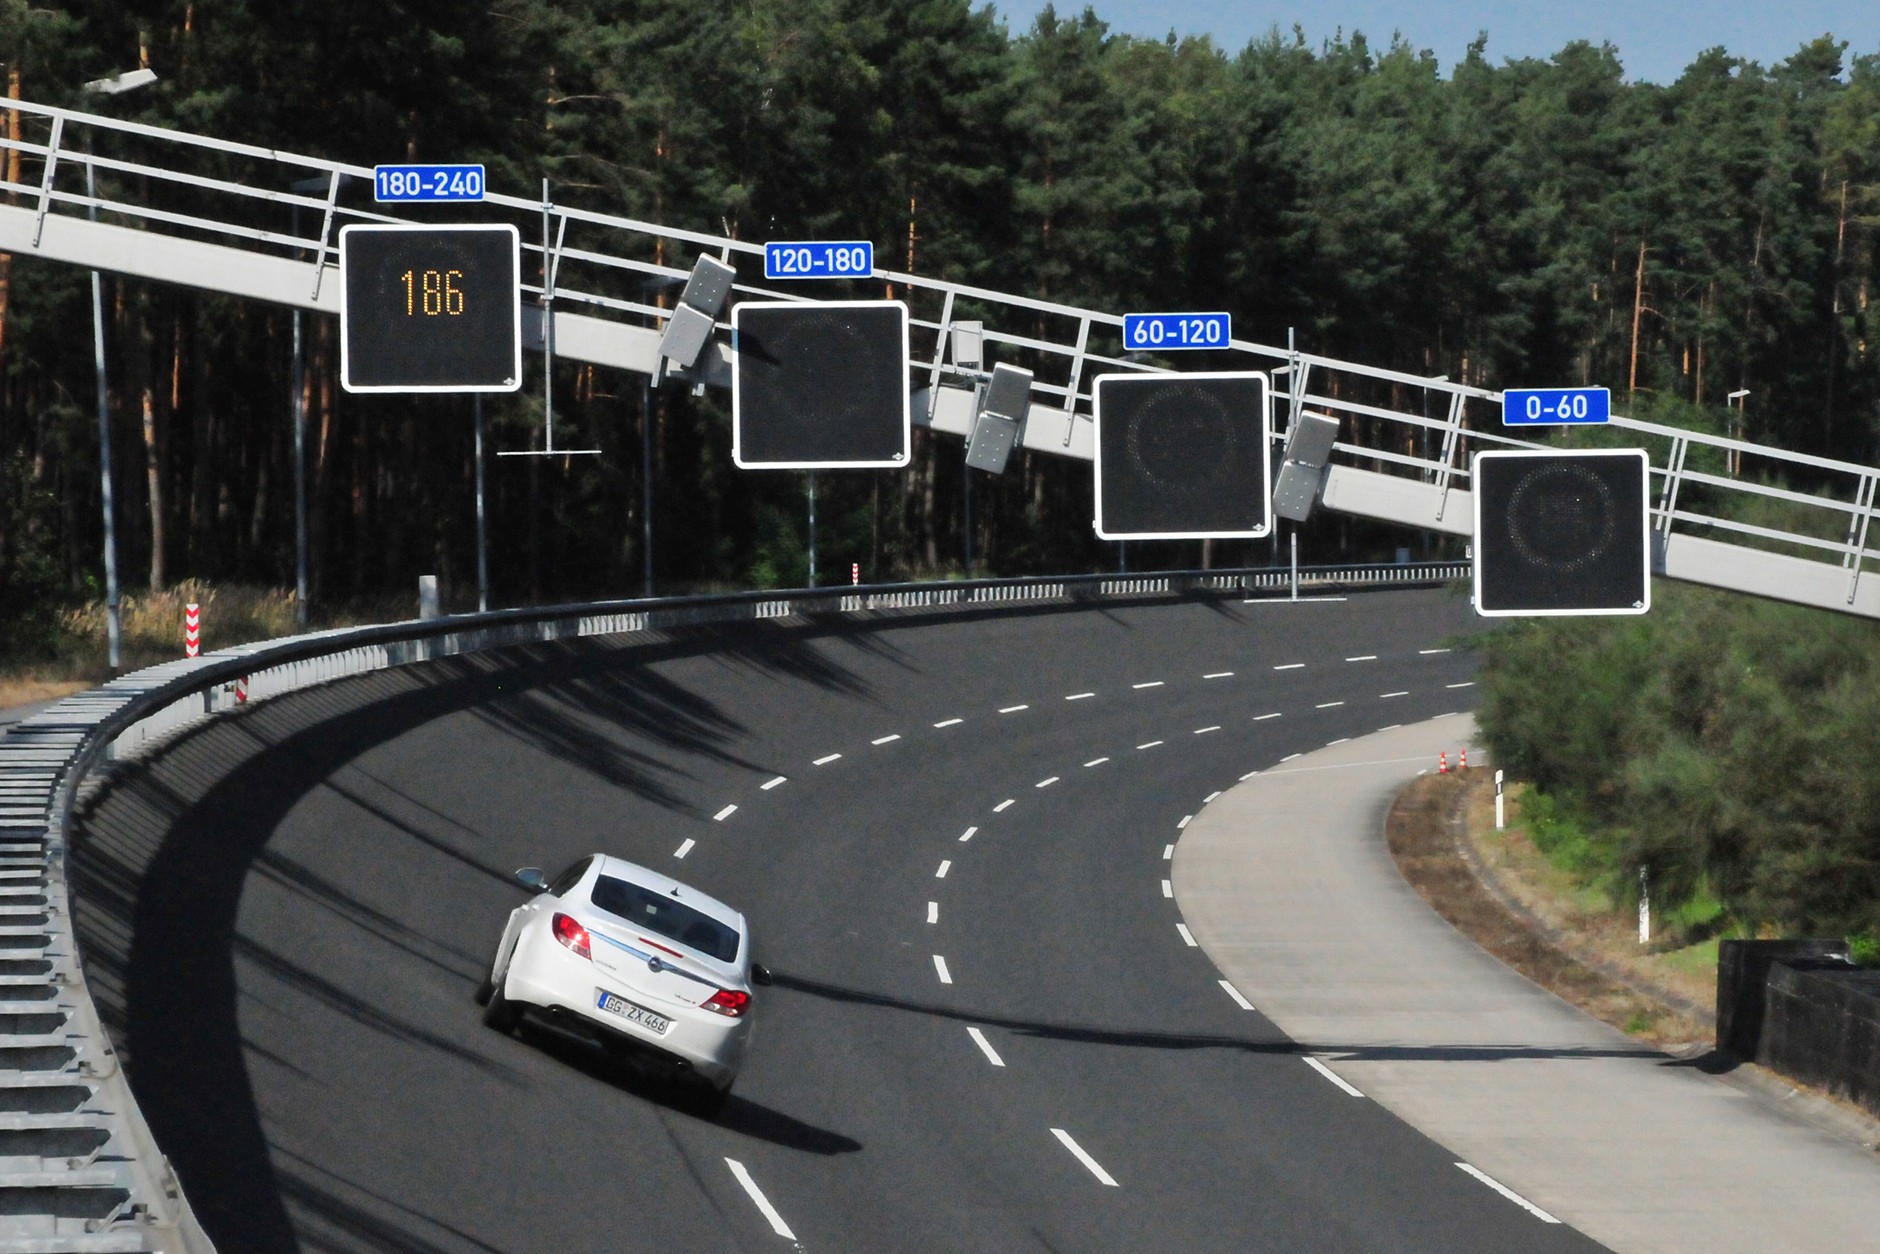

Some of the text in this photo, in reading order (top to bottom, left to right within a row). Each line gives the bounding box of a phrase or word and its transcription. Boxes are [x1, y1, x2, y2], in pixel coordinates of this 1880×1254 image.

[379, 171, 480, 196] 180-240
[772, 248, 866, 273] 120-180
[401, 270, 464, 316] 186
[1134, 319, 1220, 344] 60-120
[1526, 394, 1588, 419] 0-60
[605, 997, 666, 1032] GG ZX 466
